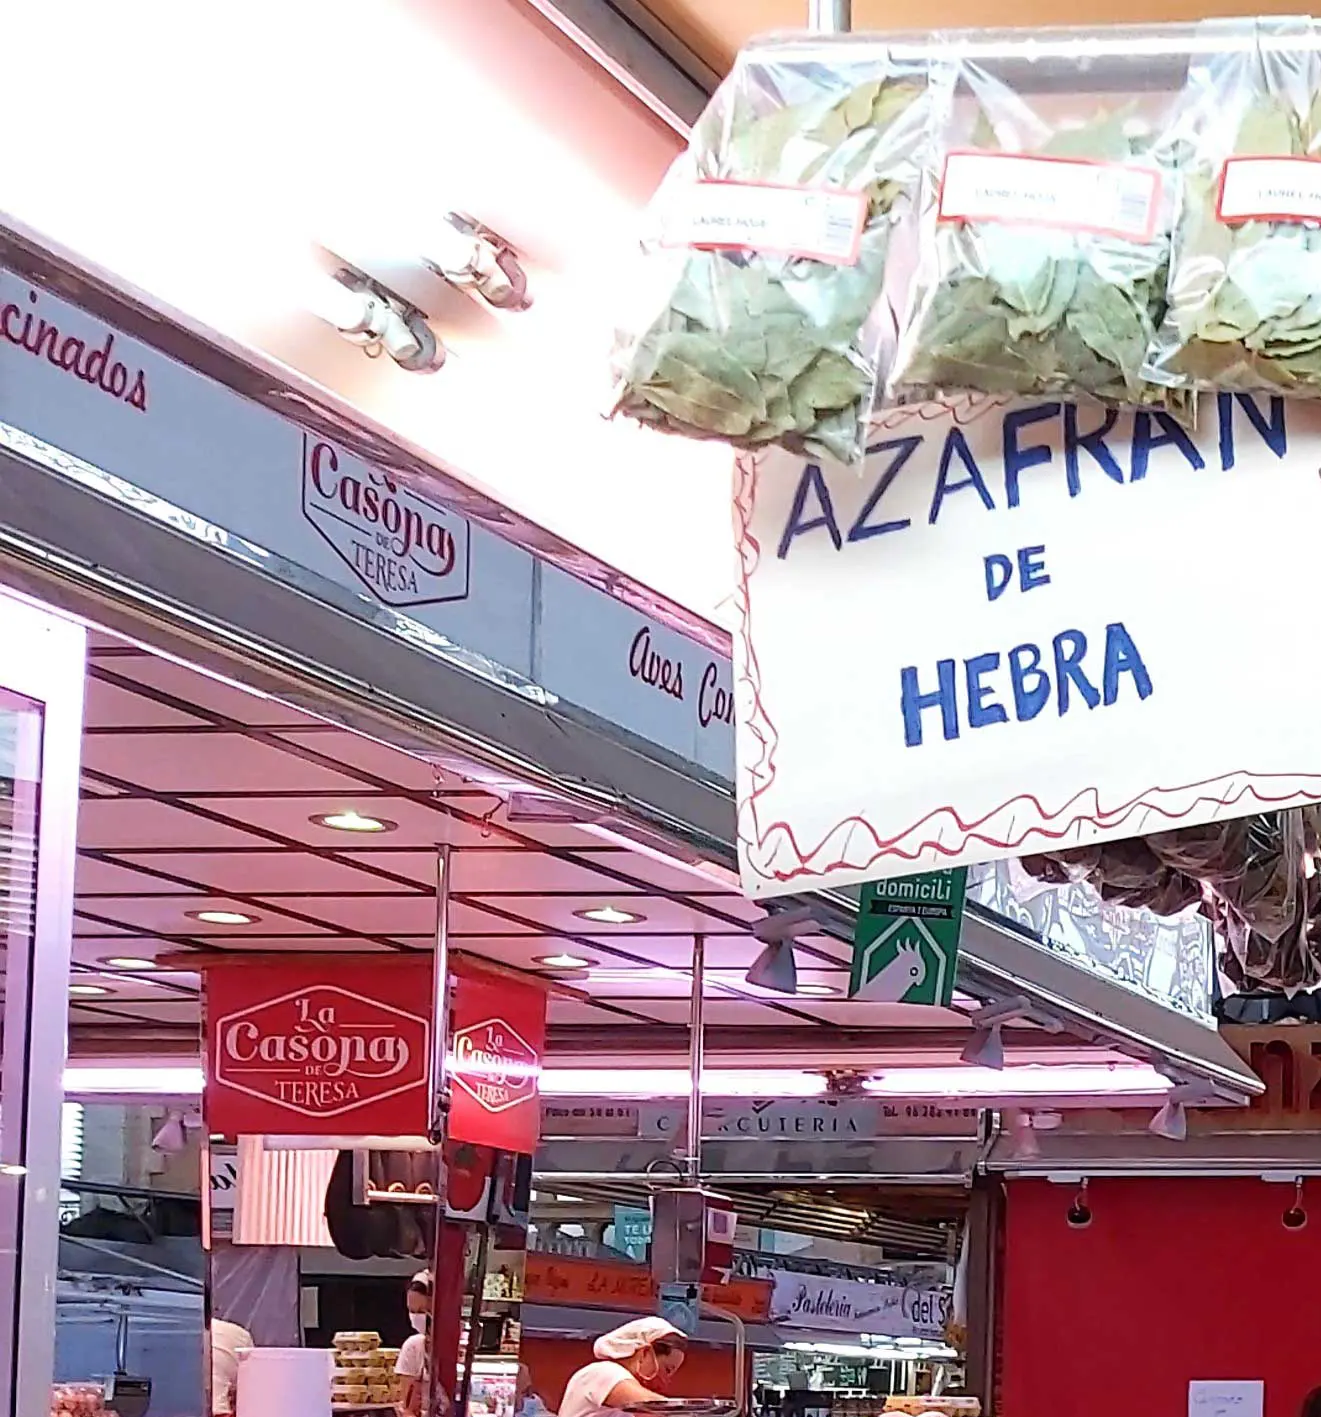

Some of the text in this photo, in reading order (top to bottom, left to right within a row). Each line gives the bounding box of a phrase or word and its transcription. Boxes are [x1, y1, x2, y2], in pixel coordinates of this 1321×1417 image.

[350, 540, 419, 595] TERESA
[983, 544, 1051, 602] DE
[901, 623, 1154, 748] HEBRA
[295, 999, 335, 1033] La
[226, 1022, 410, 1078] Casona
[304, 1066, 321, 1077] DE
[275, 1081, 361, 1107] TERESA
